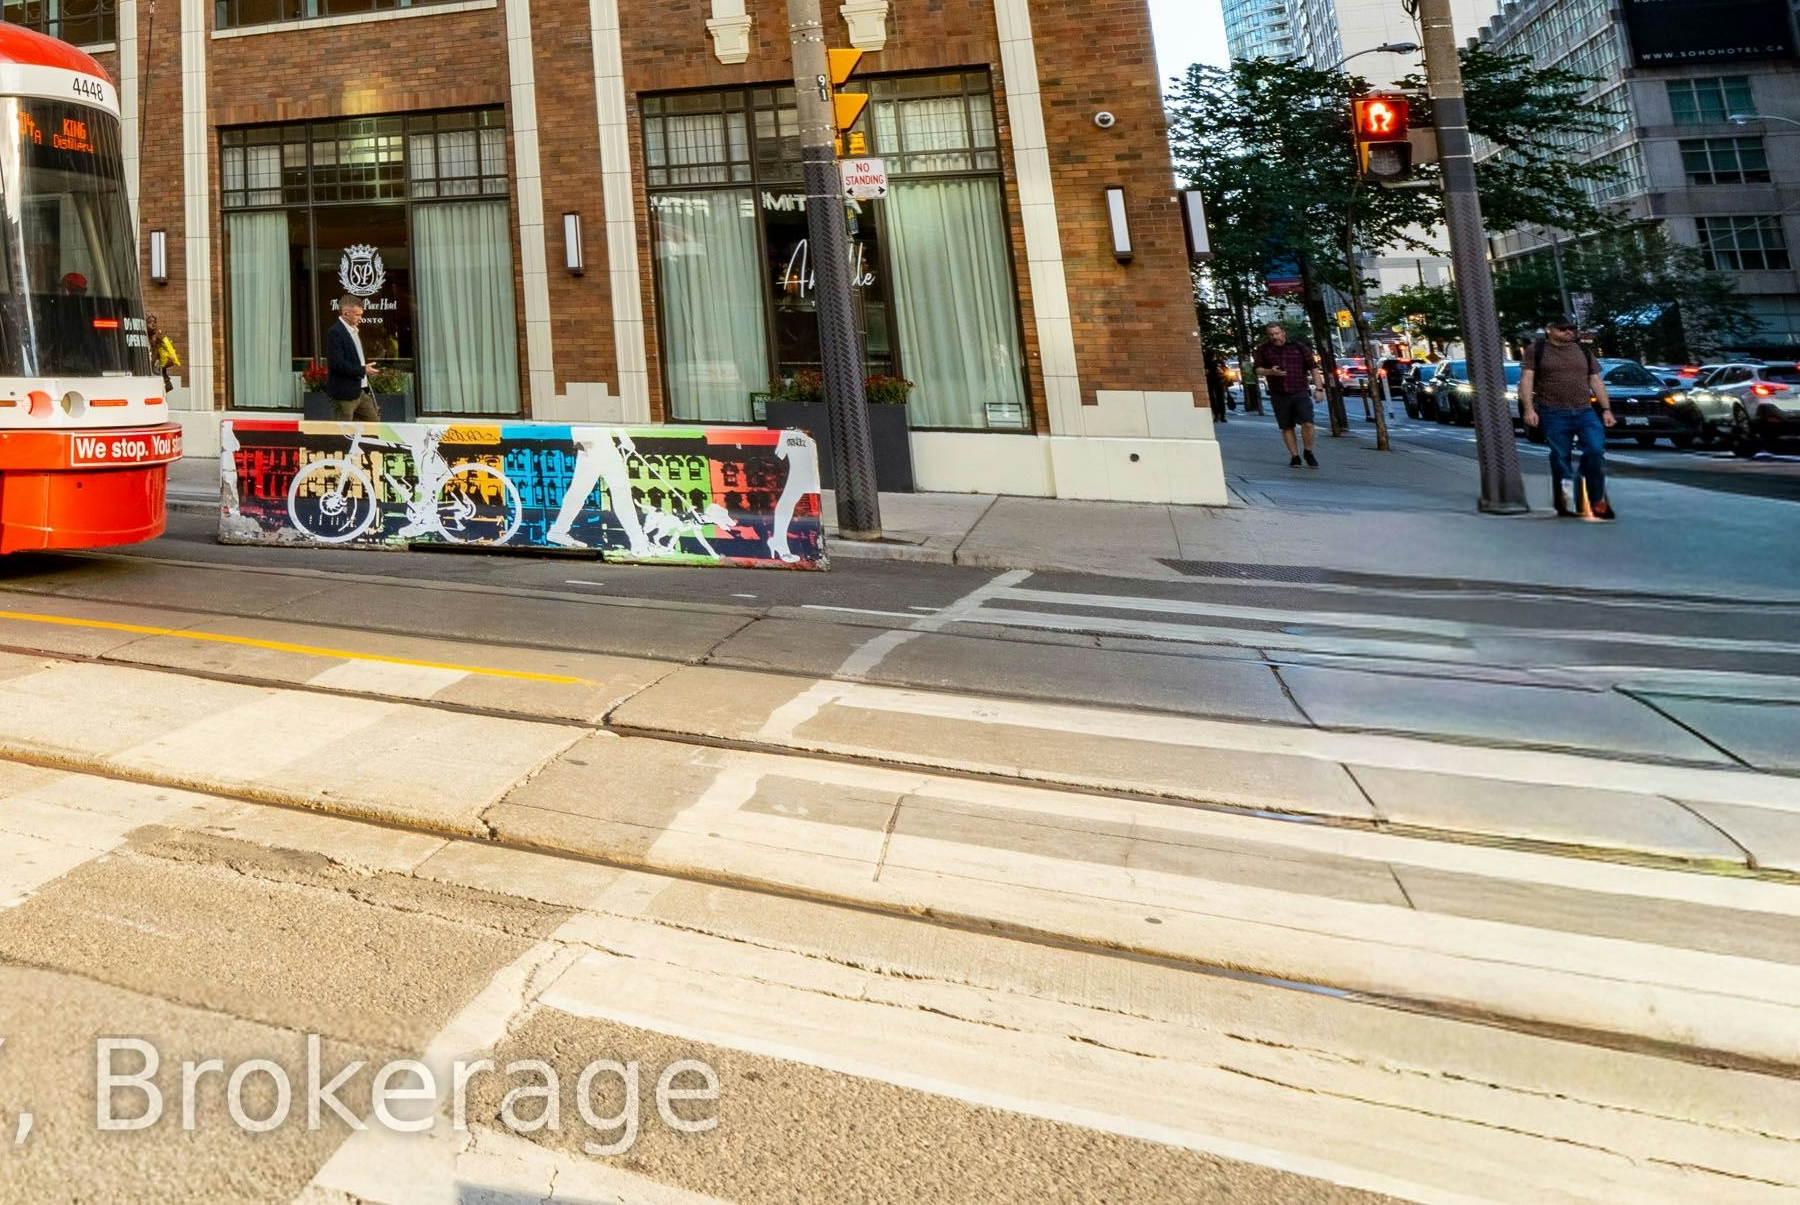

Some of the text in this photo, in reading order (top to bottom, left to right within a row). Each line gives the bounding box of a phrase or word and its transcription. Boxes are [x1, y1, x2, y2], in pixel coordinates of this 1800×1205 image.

[1642, 45, 1784, 60] WWW.SOHOHOTEL.CA
[72, 77, 104, 102] 4448
[63, 118, 87, 140] KING
[53, 134, 94, 154] Distillery
[856, 162, 870, 172] NO
[845, 175, 884, 186] STANDING
[330, 298, 397, 311] Th Place Hotel
[76, 437, 106, 459] We
[111, 438, 148, 461] stop.
[152, 435, 171, 455] You
